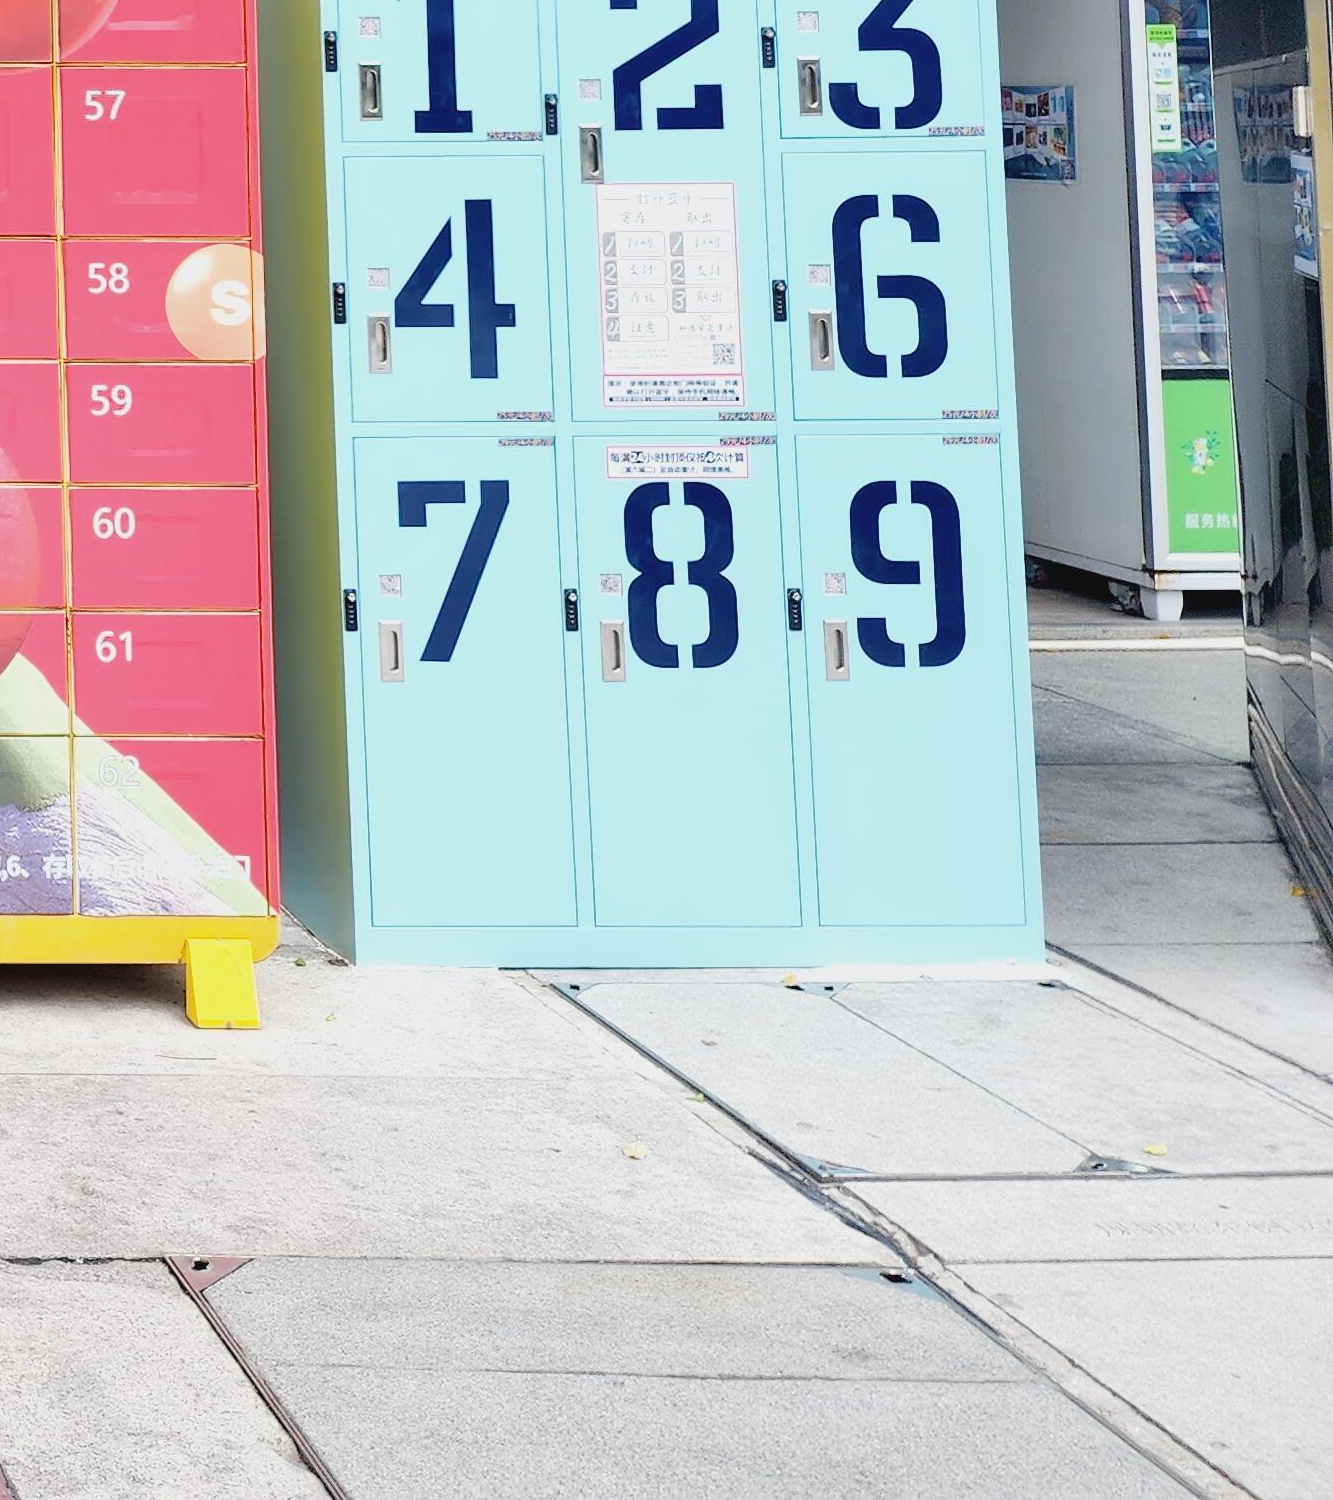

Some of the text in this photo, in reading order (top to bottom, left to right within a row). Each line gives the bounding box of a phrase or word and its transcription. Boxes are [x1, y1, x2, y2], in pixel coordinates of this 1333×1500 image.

[84, 90, 126, 121] 57
[87, 263, 130, 294] 58
[394, 199, 516, 378] 4
[831, 194, 948, 378] 6
[209, 279, 251, 326] S
[90, 385, 132, 416] 59
[92, 508, 135, 539] 60
[397, 480, 510, 662] 7
[623, 481, 740, 668] 8
[849, 480, 966, 668] 9
[95, 632, 133, 662] 61
